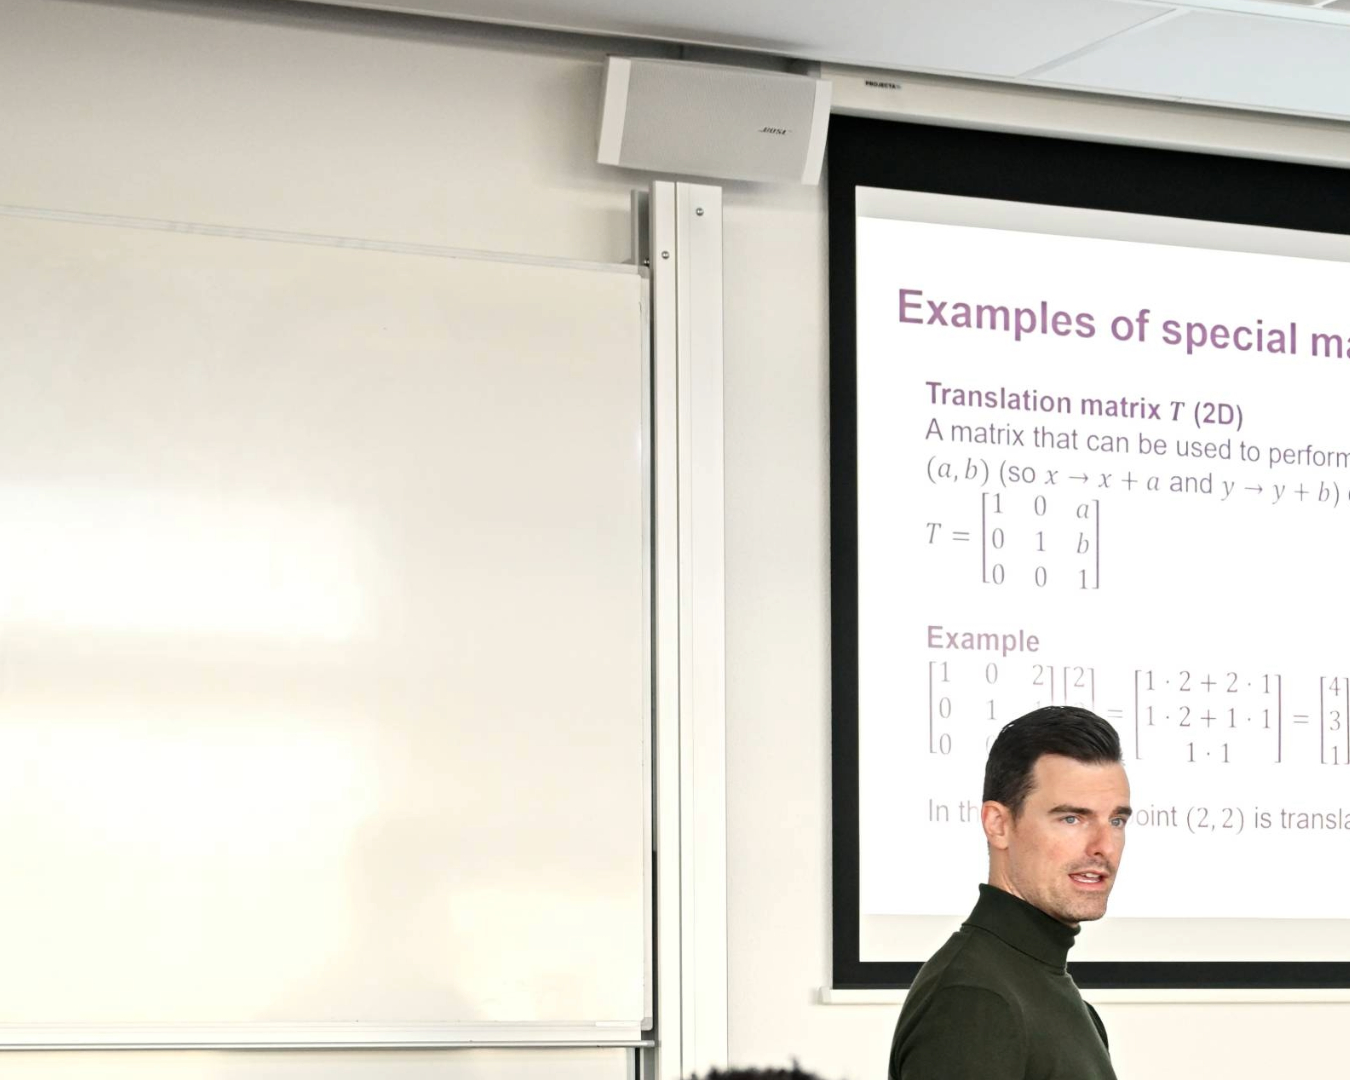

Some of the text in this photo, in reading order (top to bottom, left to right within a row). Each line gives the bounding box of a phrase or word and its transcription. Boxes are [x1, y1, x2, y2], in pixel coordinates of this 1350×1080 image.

[865, 80, 896, 89] PROJECTA
[899, 288, 1096, 342] Examples
[1111, 309, 1150, 342] of
[1162, 319, 1296, 355] special
[925, 381, 1243, 432] Translation matrix T (2D)
[925, 418, 943, 441] A
[952, 423, 1024, 446] matrix
[1033, 426, 1078, 450] that
[1087, 435, 1128, 453] can
[1139, 432, 1167, 455] be
[1177, 439, 1231, 460] used
[1240, 441, 1260, 462] to
[1000, 460, 1036, 488] (so
[1045, 470, 1058, 485] x
[1098, 473, 1112, 488] x
[1147, 477, 1159, 491] a
[1170, 472, 1212, 494] and
[1221, 481, 1234, 501] y
[1272, 485, 1285, 504] y
[1318, 481, 1339, 508] b)
[927, 523, 942, 544] T
[928, 625, 1039, 657] Example
[930, 799, 948, 821] In
[958, 799, 980, 823] th
[1129, 803, 1178, 827] oint
[1255, 807, 1271, 828] is
